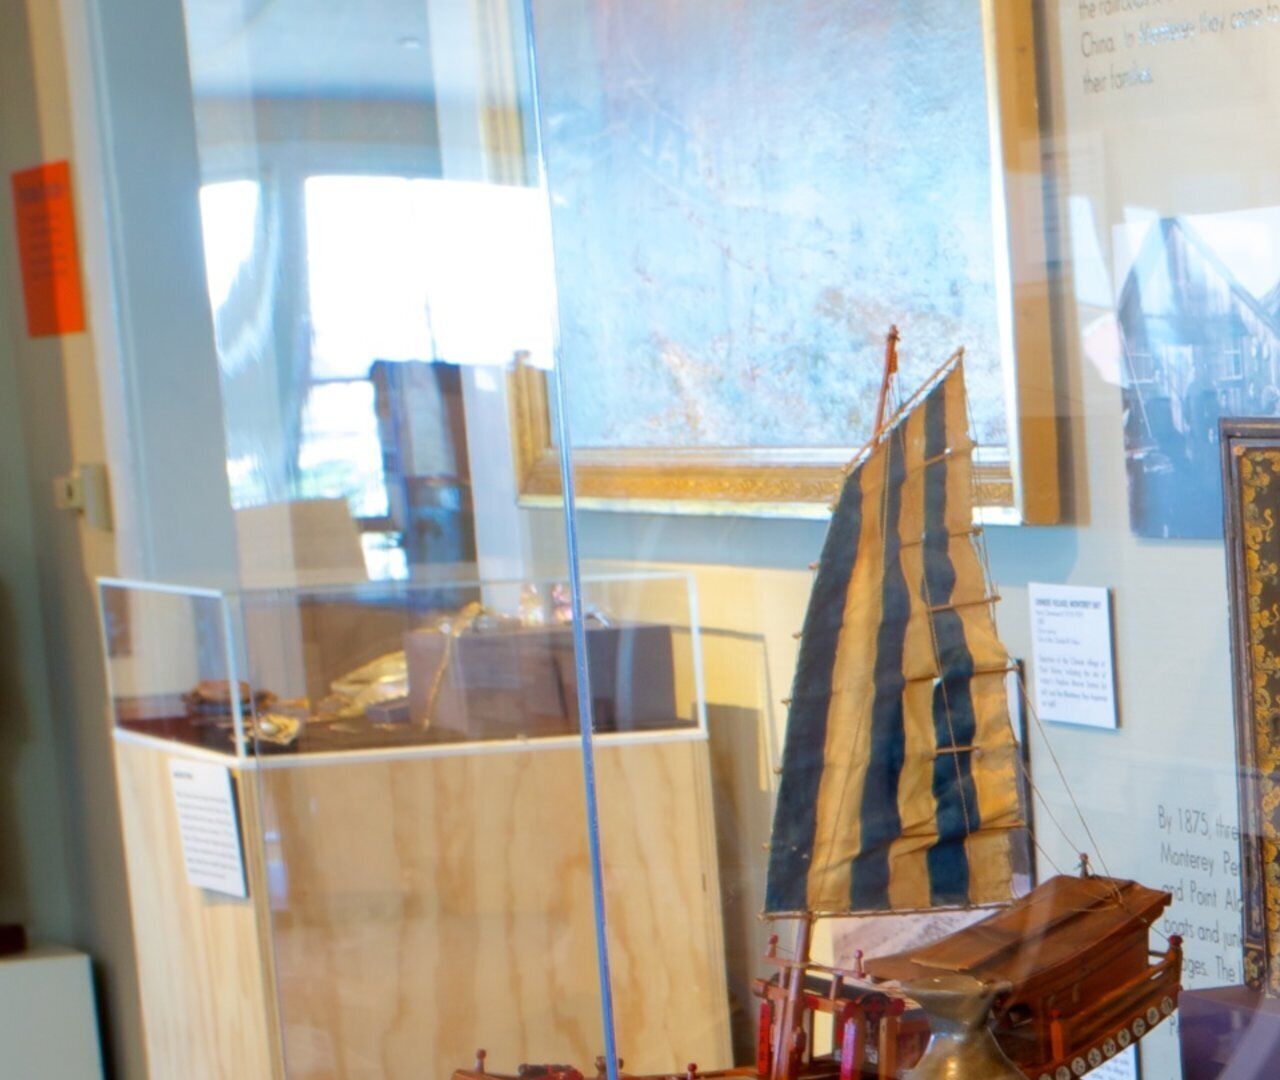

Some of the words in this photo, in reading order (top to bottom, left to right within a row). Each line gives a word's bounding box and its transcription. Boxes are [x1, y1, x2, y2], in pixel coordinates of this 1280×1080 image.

[1158, 804, 1173, 835] By
[1178, 808, 1212, 840] 1875,
[1215, 813, 1240, 840] thre
[1160, 842, 1214, 878] Monterey
[1190, 879, 1217, 907] Point
[1197, 920, 1220, 944] and
[1215, 955, 1236, 982] The
